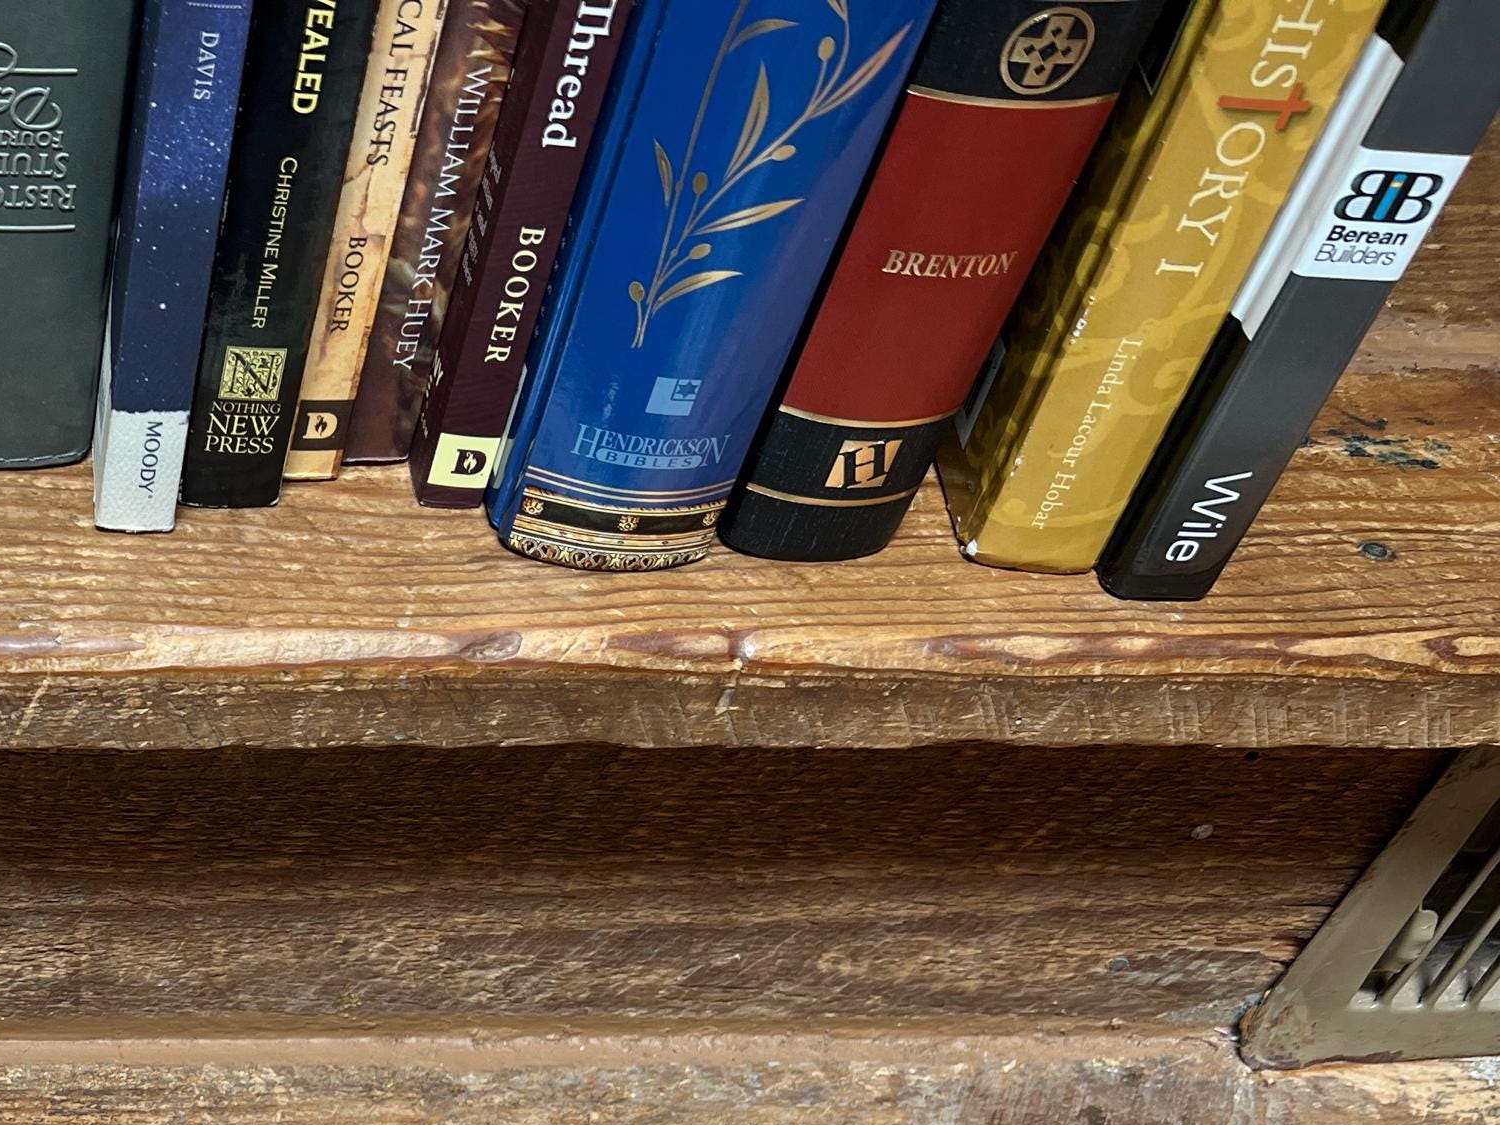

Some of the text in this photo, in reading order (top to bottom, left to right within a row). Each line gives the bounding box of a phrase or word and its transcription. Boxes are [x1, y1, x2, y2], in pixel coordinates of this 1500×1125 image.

[193, 31, 220, 100] DAVIS
[542, 0, 618, 149] Thread
[367, 66, 408, 167] FEASTS
[435, 65, 493, 199] WILLIAM
[252, 156, 297, 329] CHRISTINE MILLER
[412, 207, 455, 289] MARK
[881, 249, 1018, 279] BRENTON
[1314, 243, 1397, 266] Builders
[1326, 225, 1409, 246] Berean
[331, 236, 368, 332] BOOKER
[484, 226, 546, 363] BOOKER
[393, 299, 432, 370] HUEY
[207, 412, 281, 437] NEW
[211, 401, 281, 414] NOTHING
[1031, 337, 1143, 530] Linda Lacour Hobar
[204, 434, 275, 454] PRESS
[570, 422, 733, 467] HENDRICKSON
[602, 452, 694, 468] BIBLES
[1165, 472, 1253, 562] Wile
